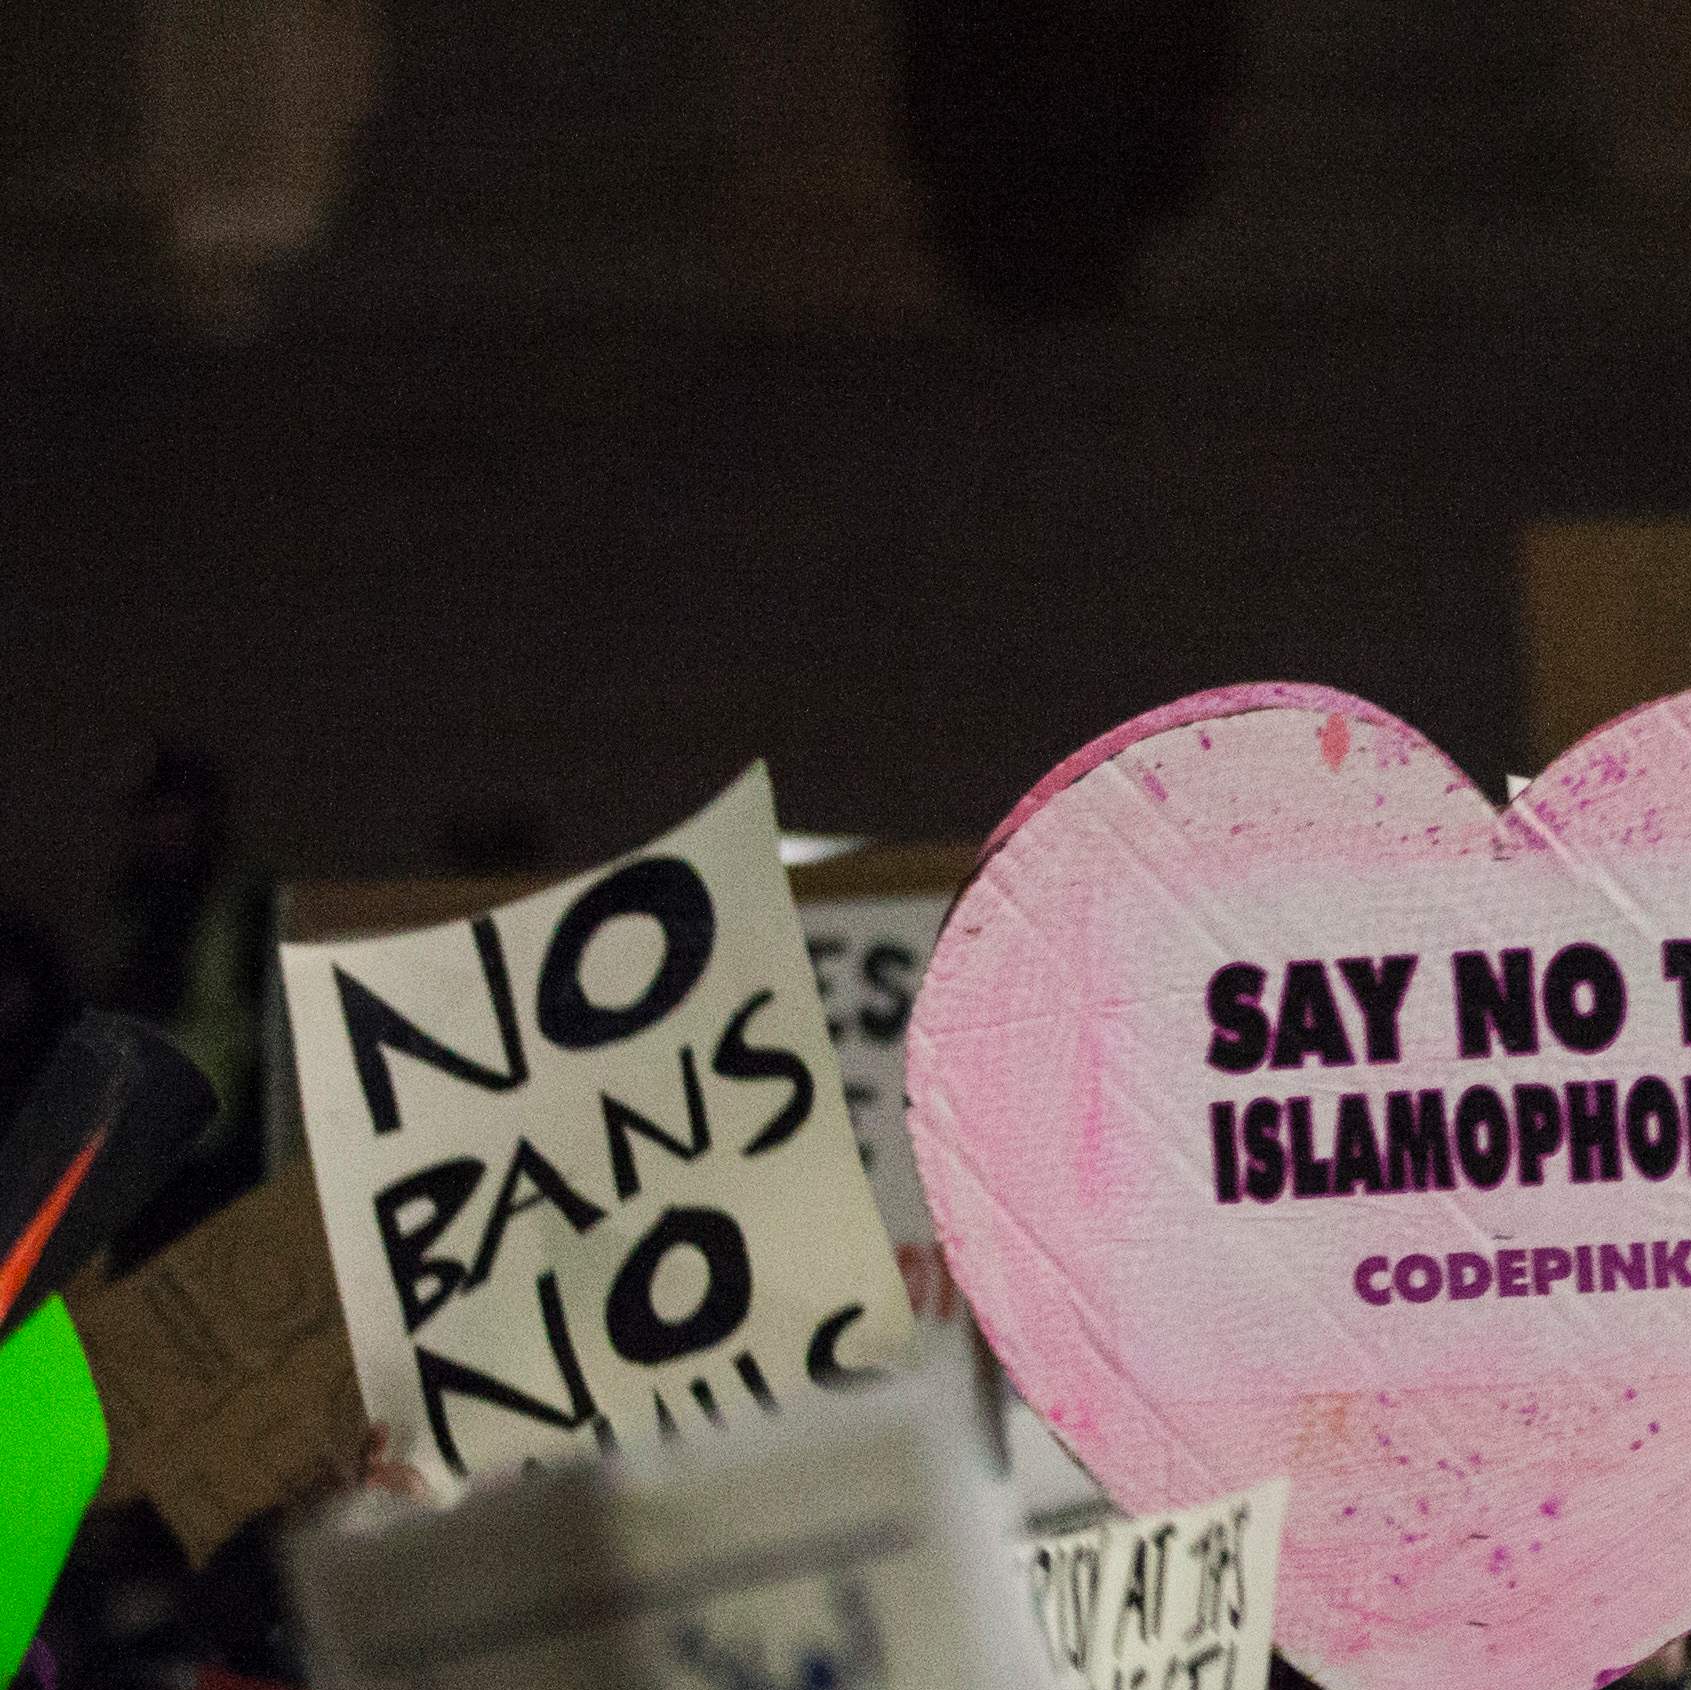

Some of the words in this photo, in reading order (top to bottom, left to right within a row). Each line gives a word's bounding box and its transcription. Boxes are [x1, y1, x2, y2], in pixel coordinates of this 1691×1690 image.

[333, 857, 716, 1134] NO
[1204, 952, 1420, 1075] SAY
[1450, 940, 1628, 1060] NO
[374, 988, 816, 1335] BANS
[415, 1205, 753, 1478] NO
